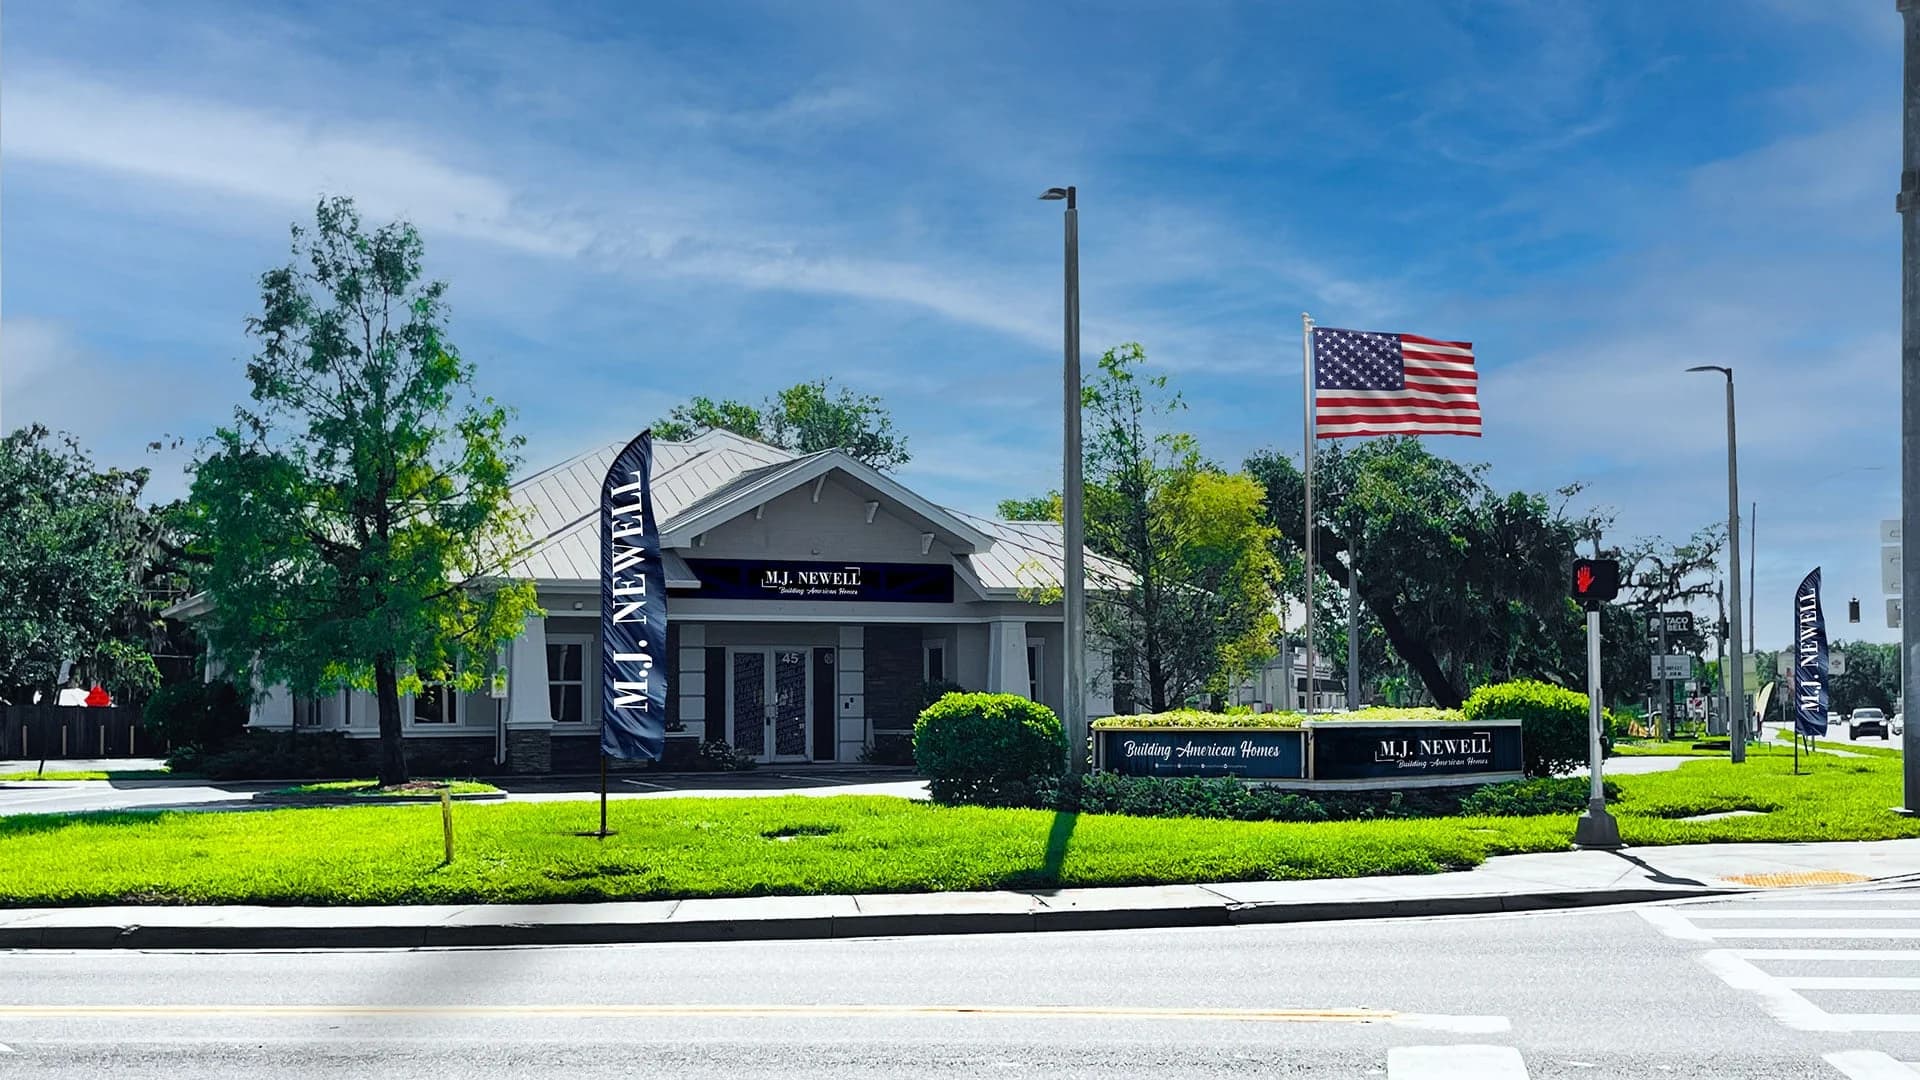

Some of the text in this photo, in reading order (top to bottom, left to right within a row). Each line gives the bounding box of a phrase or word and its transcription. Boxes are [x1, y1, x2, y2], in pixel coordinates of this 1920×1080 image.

[766, 571, 861, 585] M.J. NEWELL
[611, 470, 653, 712] M.J. NEWELL
[779, 587, 805, 595] Building
[806, 587, 837, 595] American
[1665, 616, 1689, 624] TACO
[1800, 588, 1822, 712] M.J. NEWELL
[782, 653, 799, 664] 45
[1124, 740, 1280, 760] Building American Homes
[1380, 739, 1491, 758] M.J. NEWELL
[1397, 757, 1489, 768] Building American Homes
